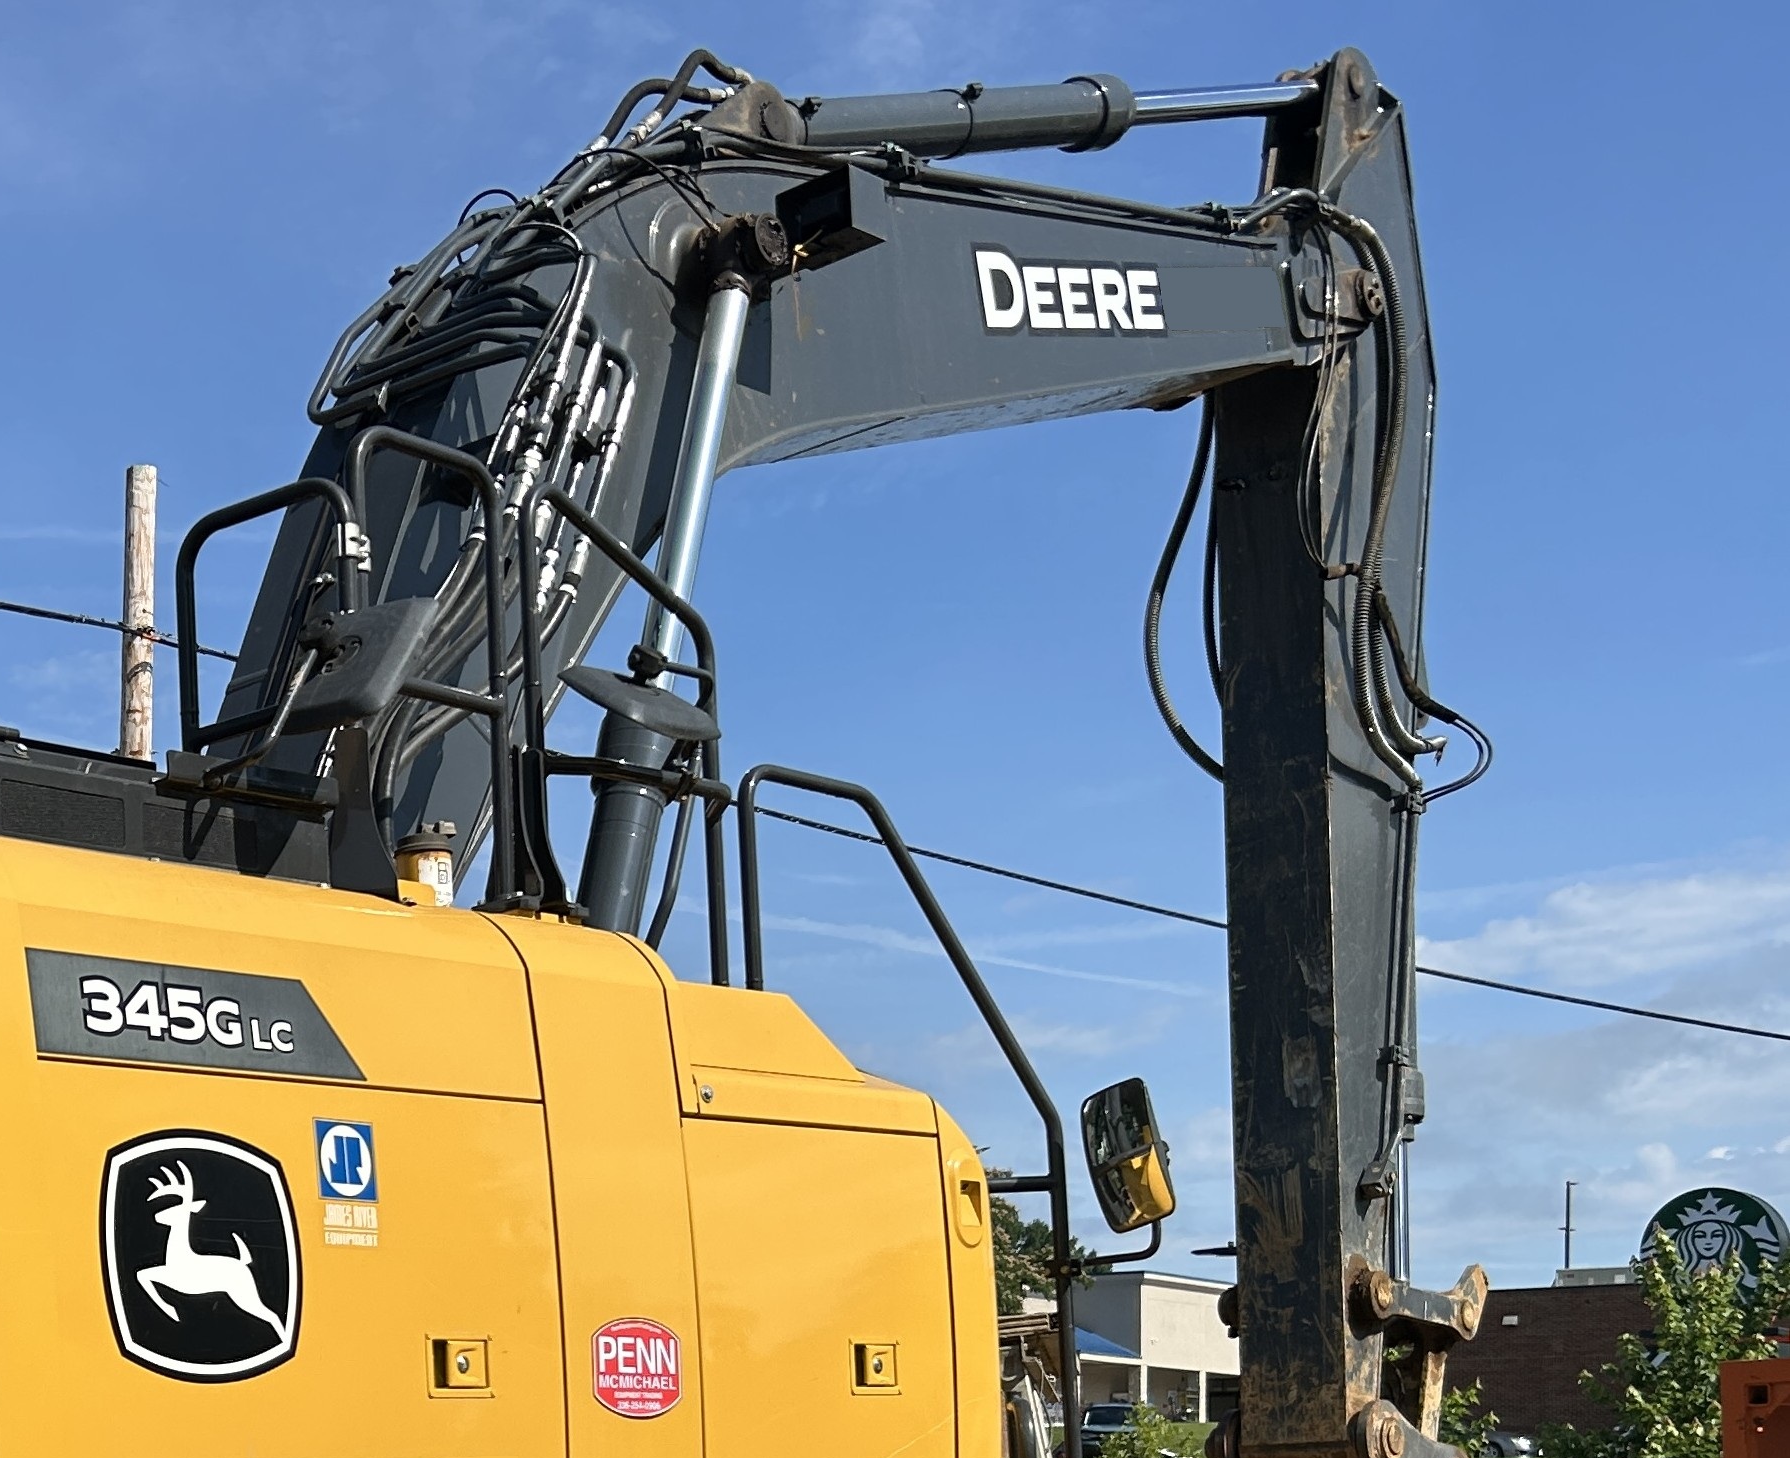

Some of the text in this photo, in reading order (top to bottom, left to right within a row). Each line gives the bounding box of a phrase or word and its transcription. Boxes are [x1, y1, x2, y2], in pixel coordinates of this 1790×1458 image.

[975, 250, 1166, 330] DEERE
[81, 978, 295, 1052] 345G LC
[597, 1335, 677, 1375] PENN
[598, 1375, 677, 1390] MCMICHAEL
